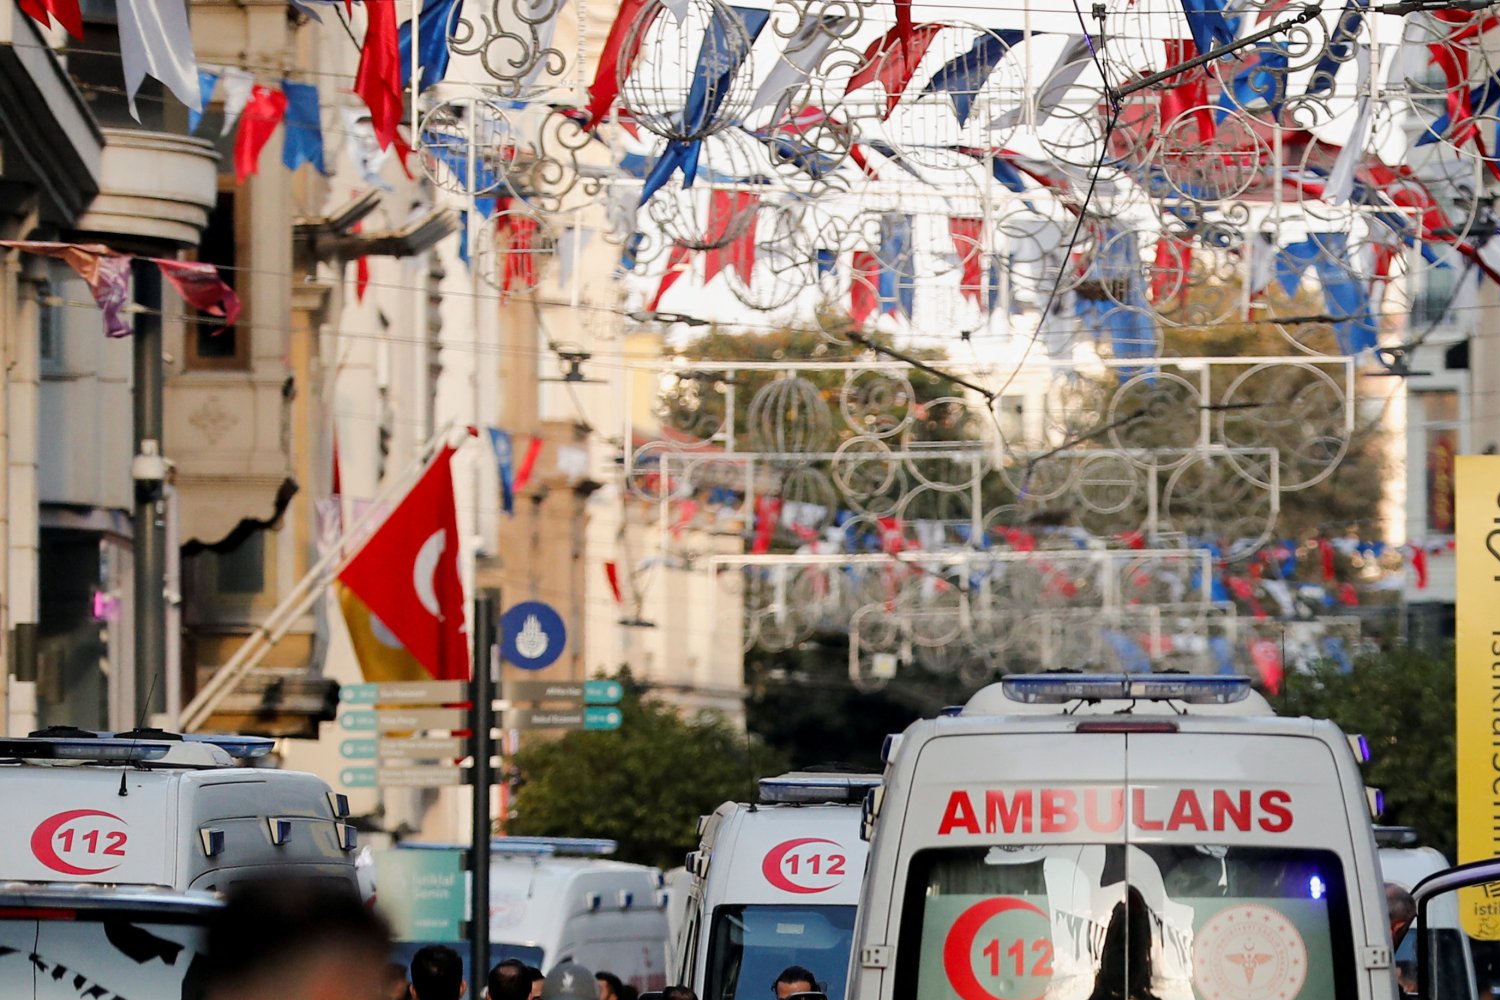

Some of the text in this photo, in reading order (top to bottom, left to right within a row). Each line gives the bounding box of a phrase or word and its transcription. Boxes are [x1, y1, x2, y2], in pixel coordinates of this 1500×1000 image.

[938, 789, 1294, 835] AMBULANS
[58, 828, 128, 856] 112
[785, 854, 846, 875] 112
[983, 938, 1053, 977] 112
